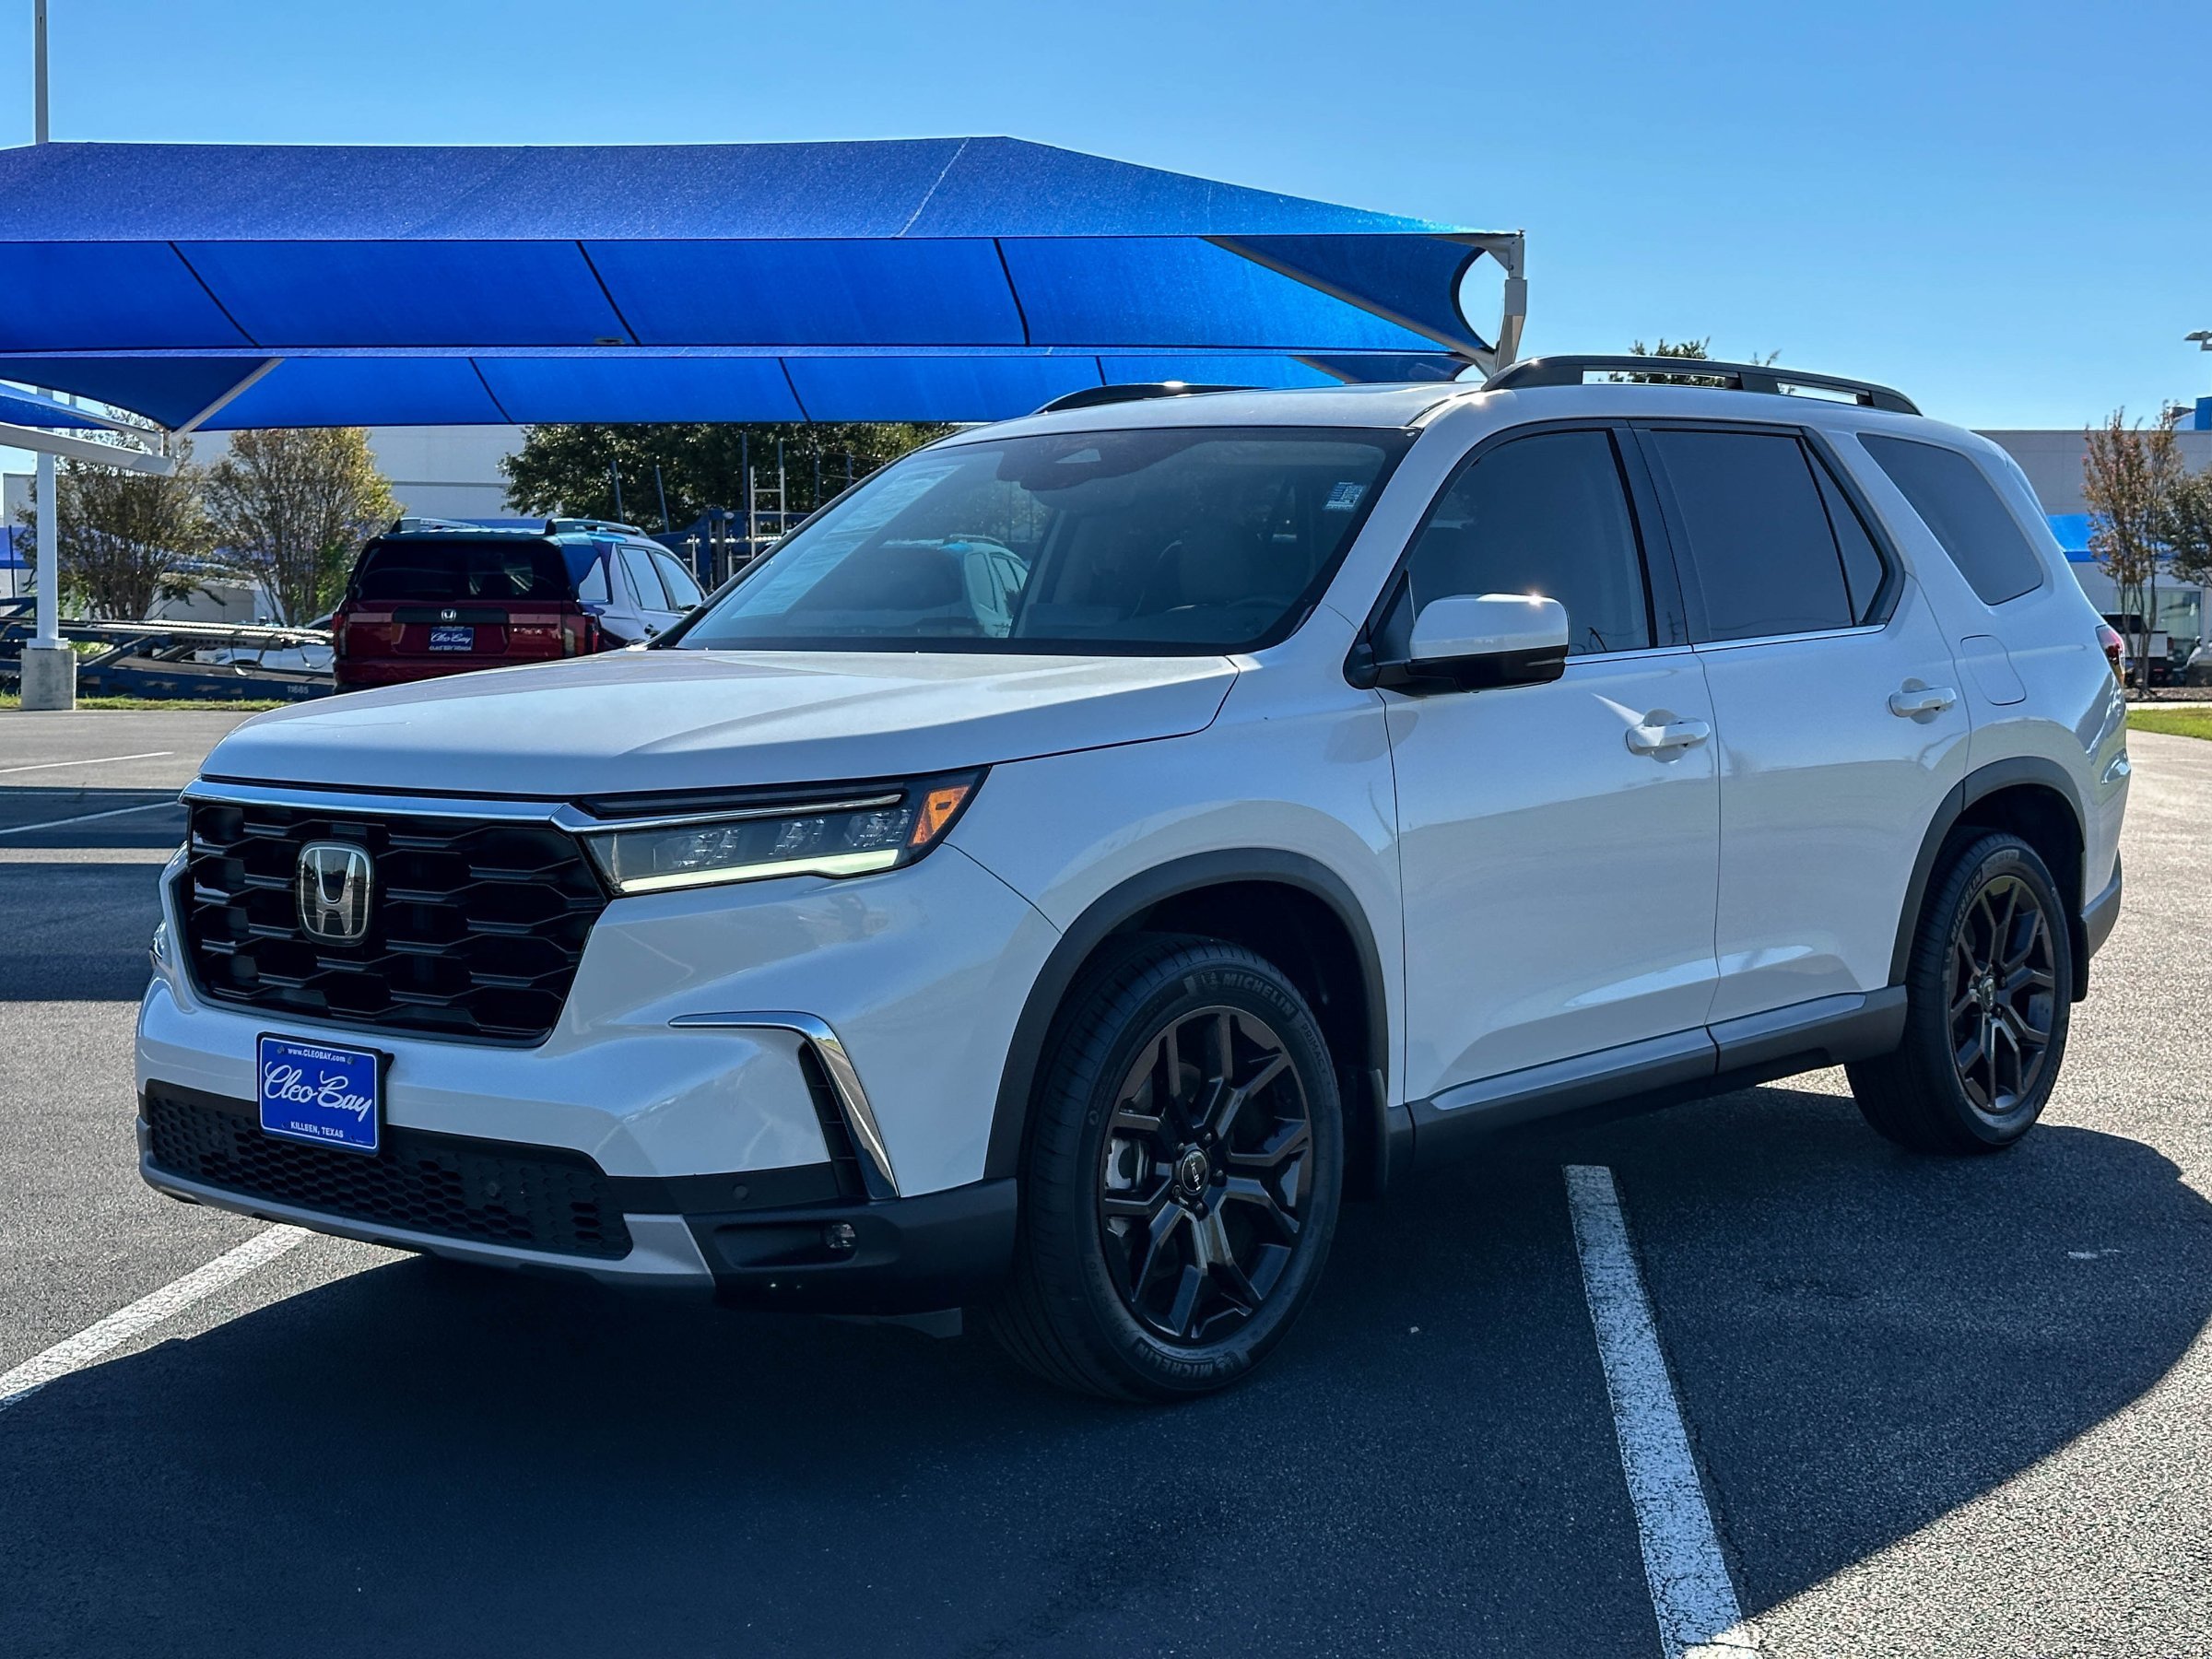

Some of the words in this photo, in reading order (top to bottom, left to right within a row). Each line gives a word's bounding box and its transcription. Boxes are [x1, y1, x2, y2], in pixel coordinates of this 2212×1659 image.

[1950, 870, 1983, 943] MICHELIN
[1222, 972, 1298, 1018] MICHELIN
[288, 1047, 346, 1063] www.CLEOBAY.com
[1300, 1023, 1329, 1076] PRIMACY
[264, 1061, 318, 1103] Cleo
[317, 1070, 372, 1123] Bay
[290, 1121, 320, 1135] KILLEEN,
[322, 1126, 344, 1138] TEXAS
[1135, 1342, 1213, 1379] MICHELIN
